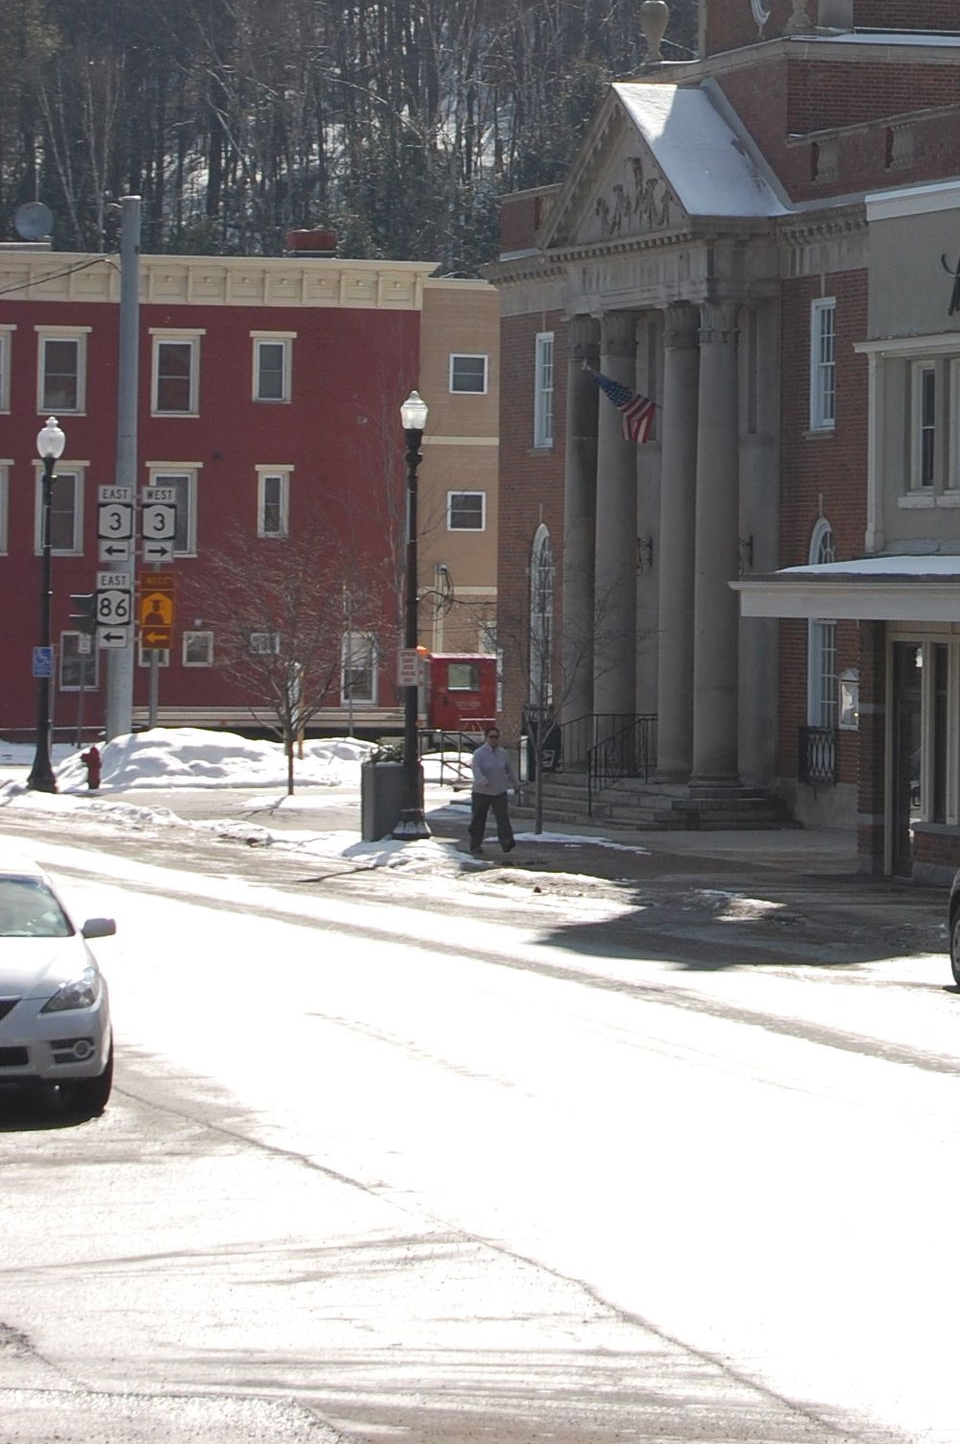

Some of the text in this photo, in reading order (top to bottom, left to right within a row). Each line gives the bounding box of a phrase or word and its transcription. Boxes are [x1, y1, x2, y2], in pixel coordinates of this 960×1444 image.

[102, 489, 128, 500] EAST
[147, 490, 173, 500] WEST
[109, 512, 122, 531] 3
[153, 513, 165, 531] 3
[101, 575, 127, 586] EAST
[99, 597, 128, 617] 86
